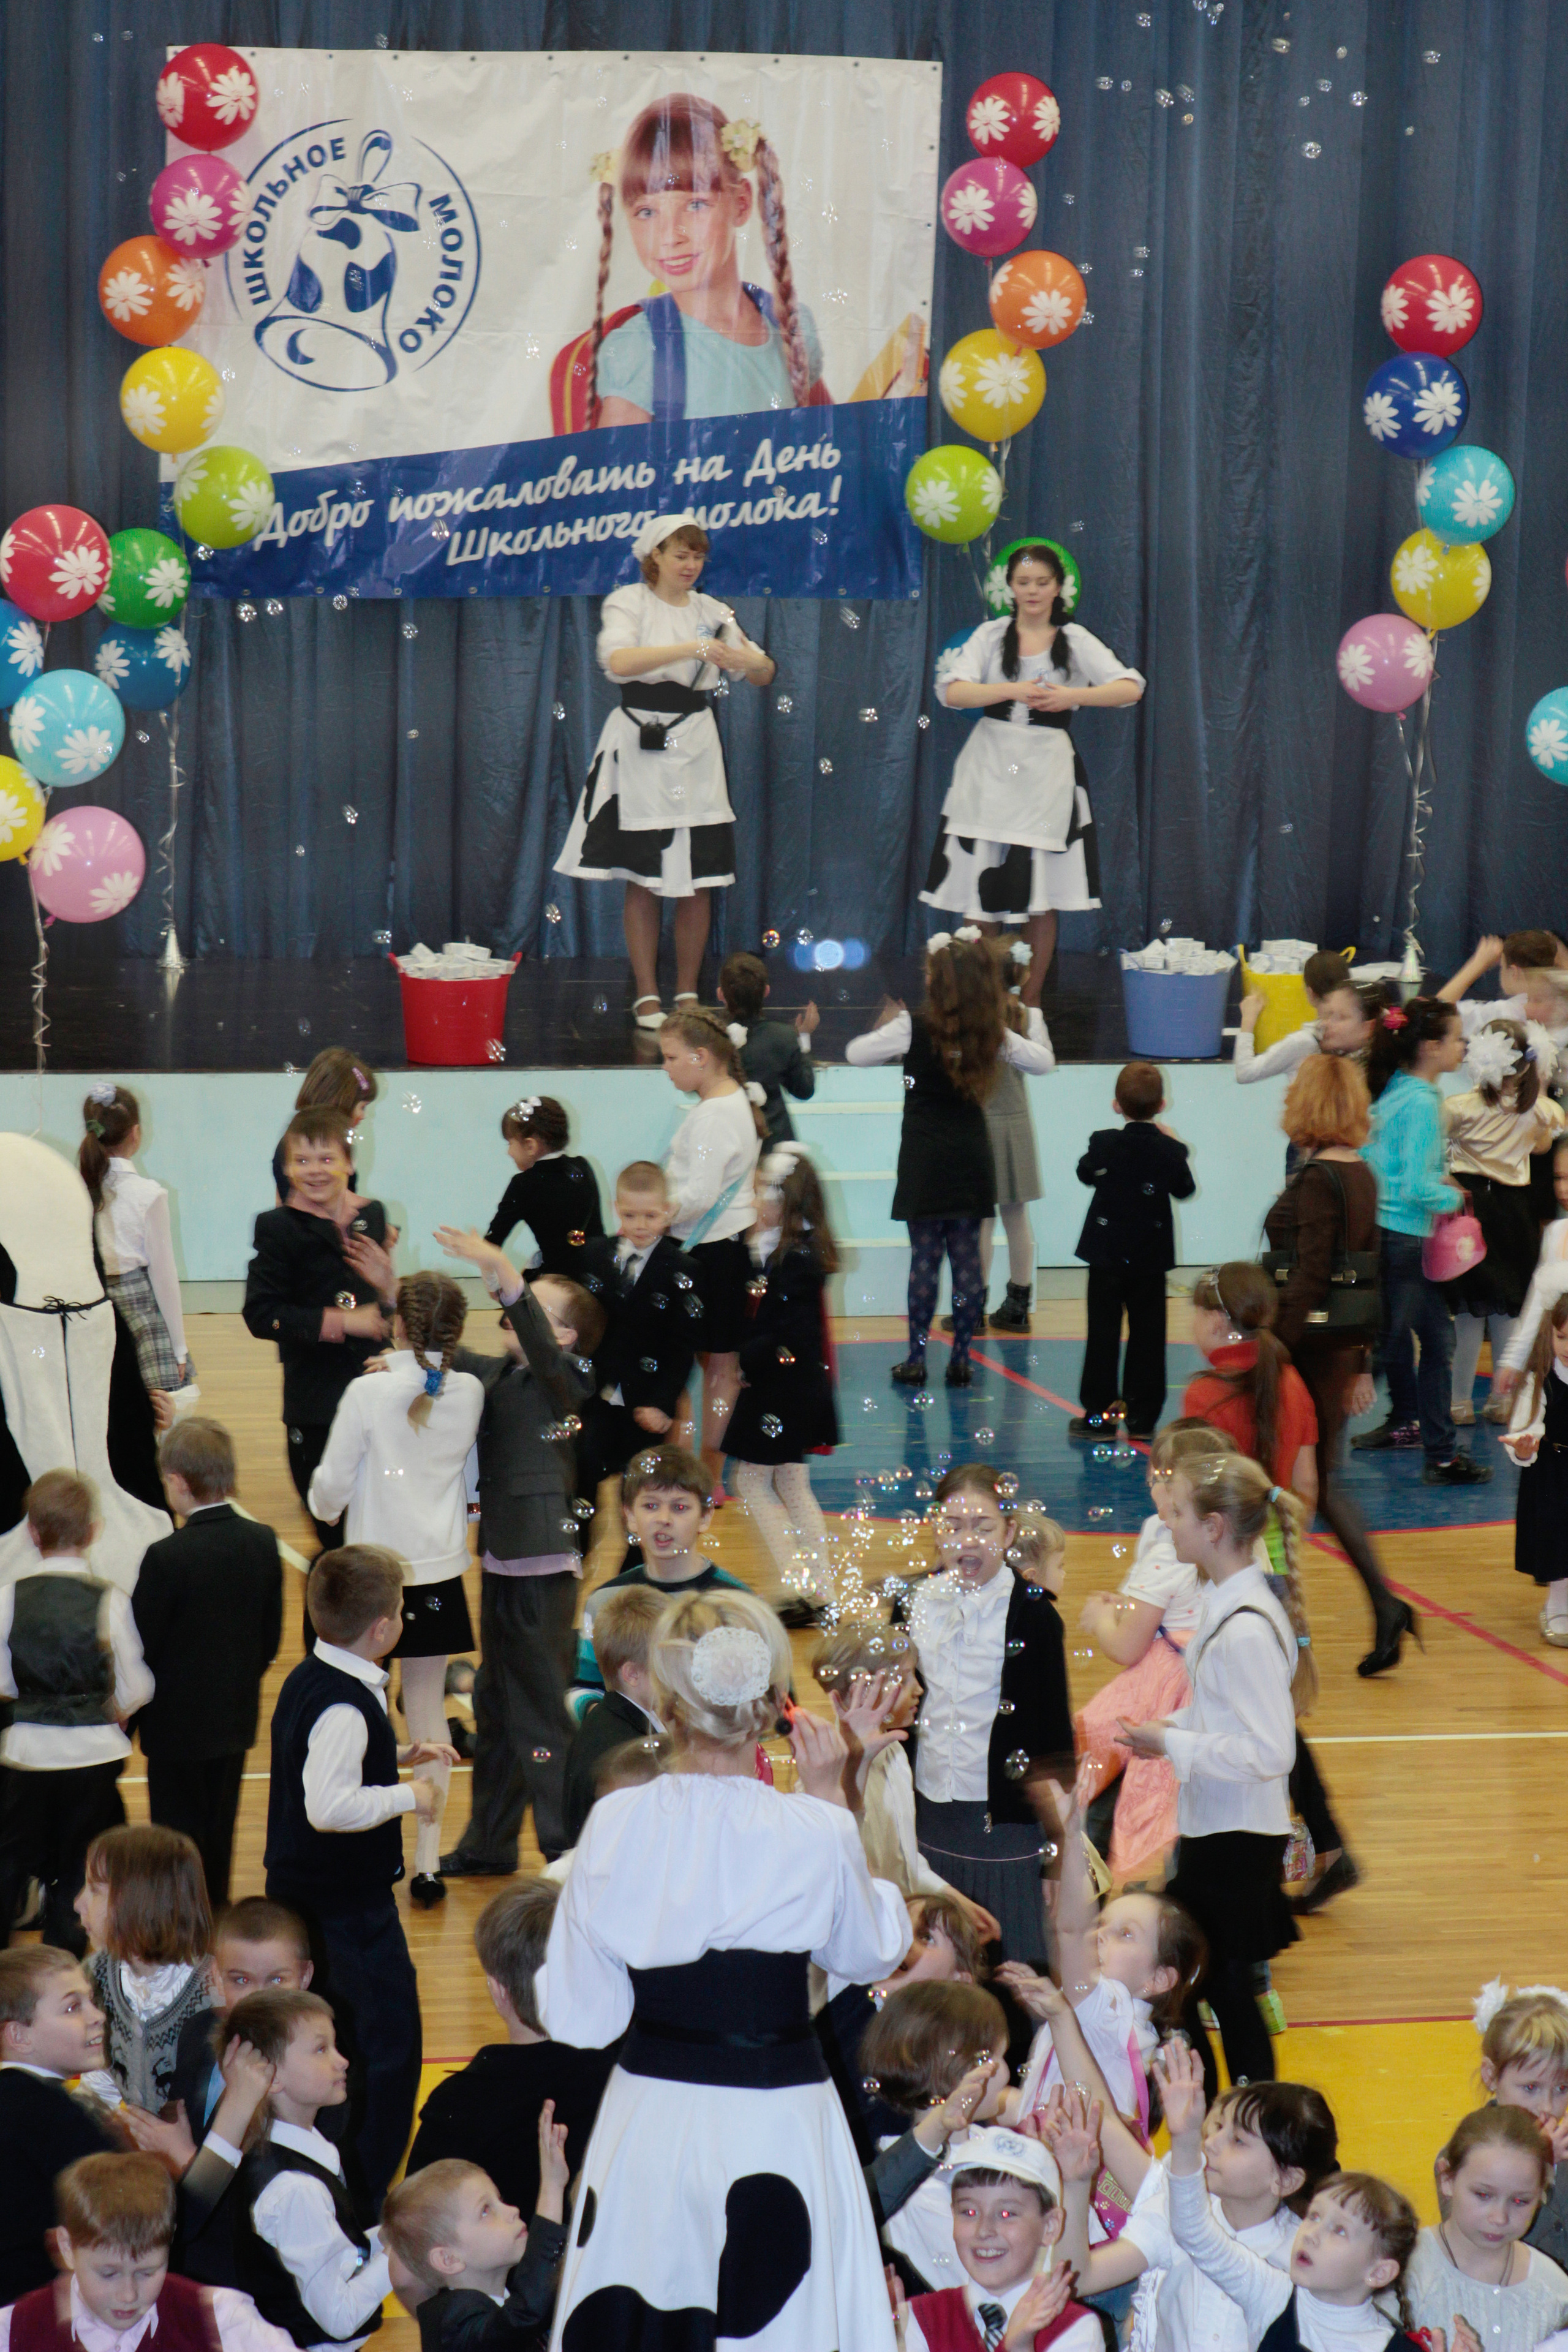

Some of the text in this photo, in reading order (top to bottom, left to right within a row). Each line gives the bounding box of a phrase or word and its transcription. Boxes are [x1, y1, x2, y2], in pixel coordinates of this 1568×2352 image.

[243, 137, 464, 353] ШКОЛЬНОЕ МОЛОКО
[252, 438, 841, 551] Добро пожаловать на День
[446, 510, 656, 566] Школьного
